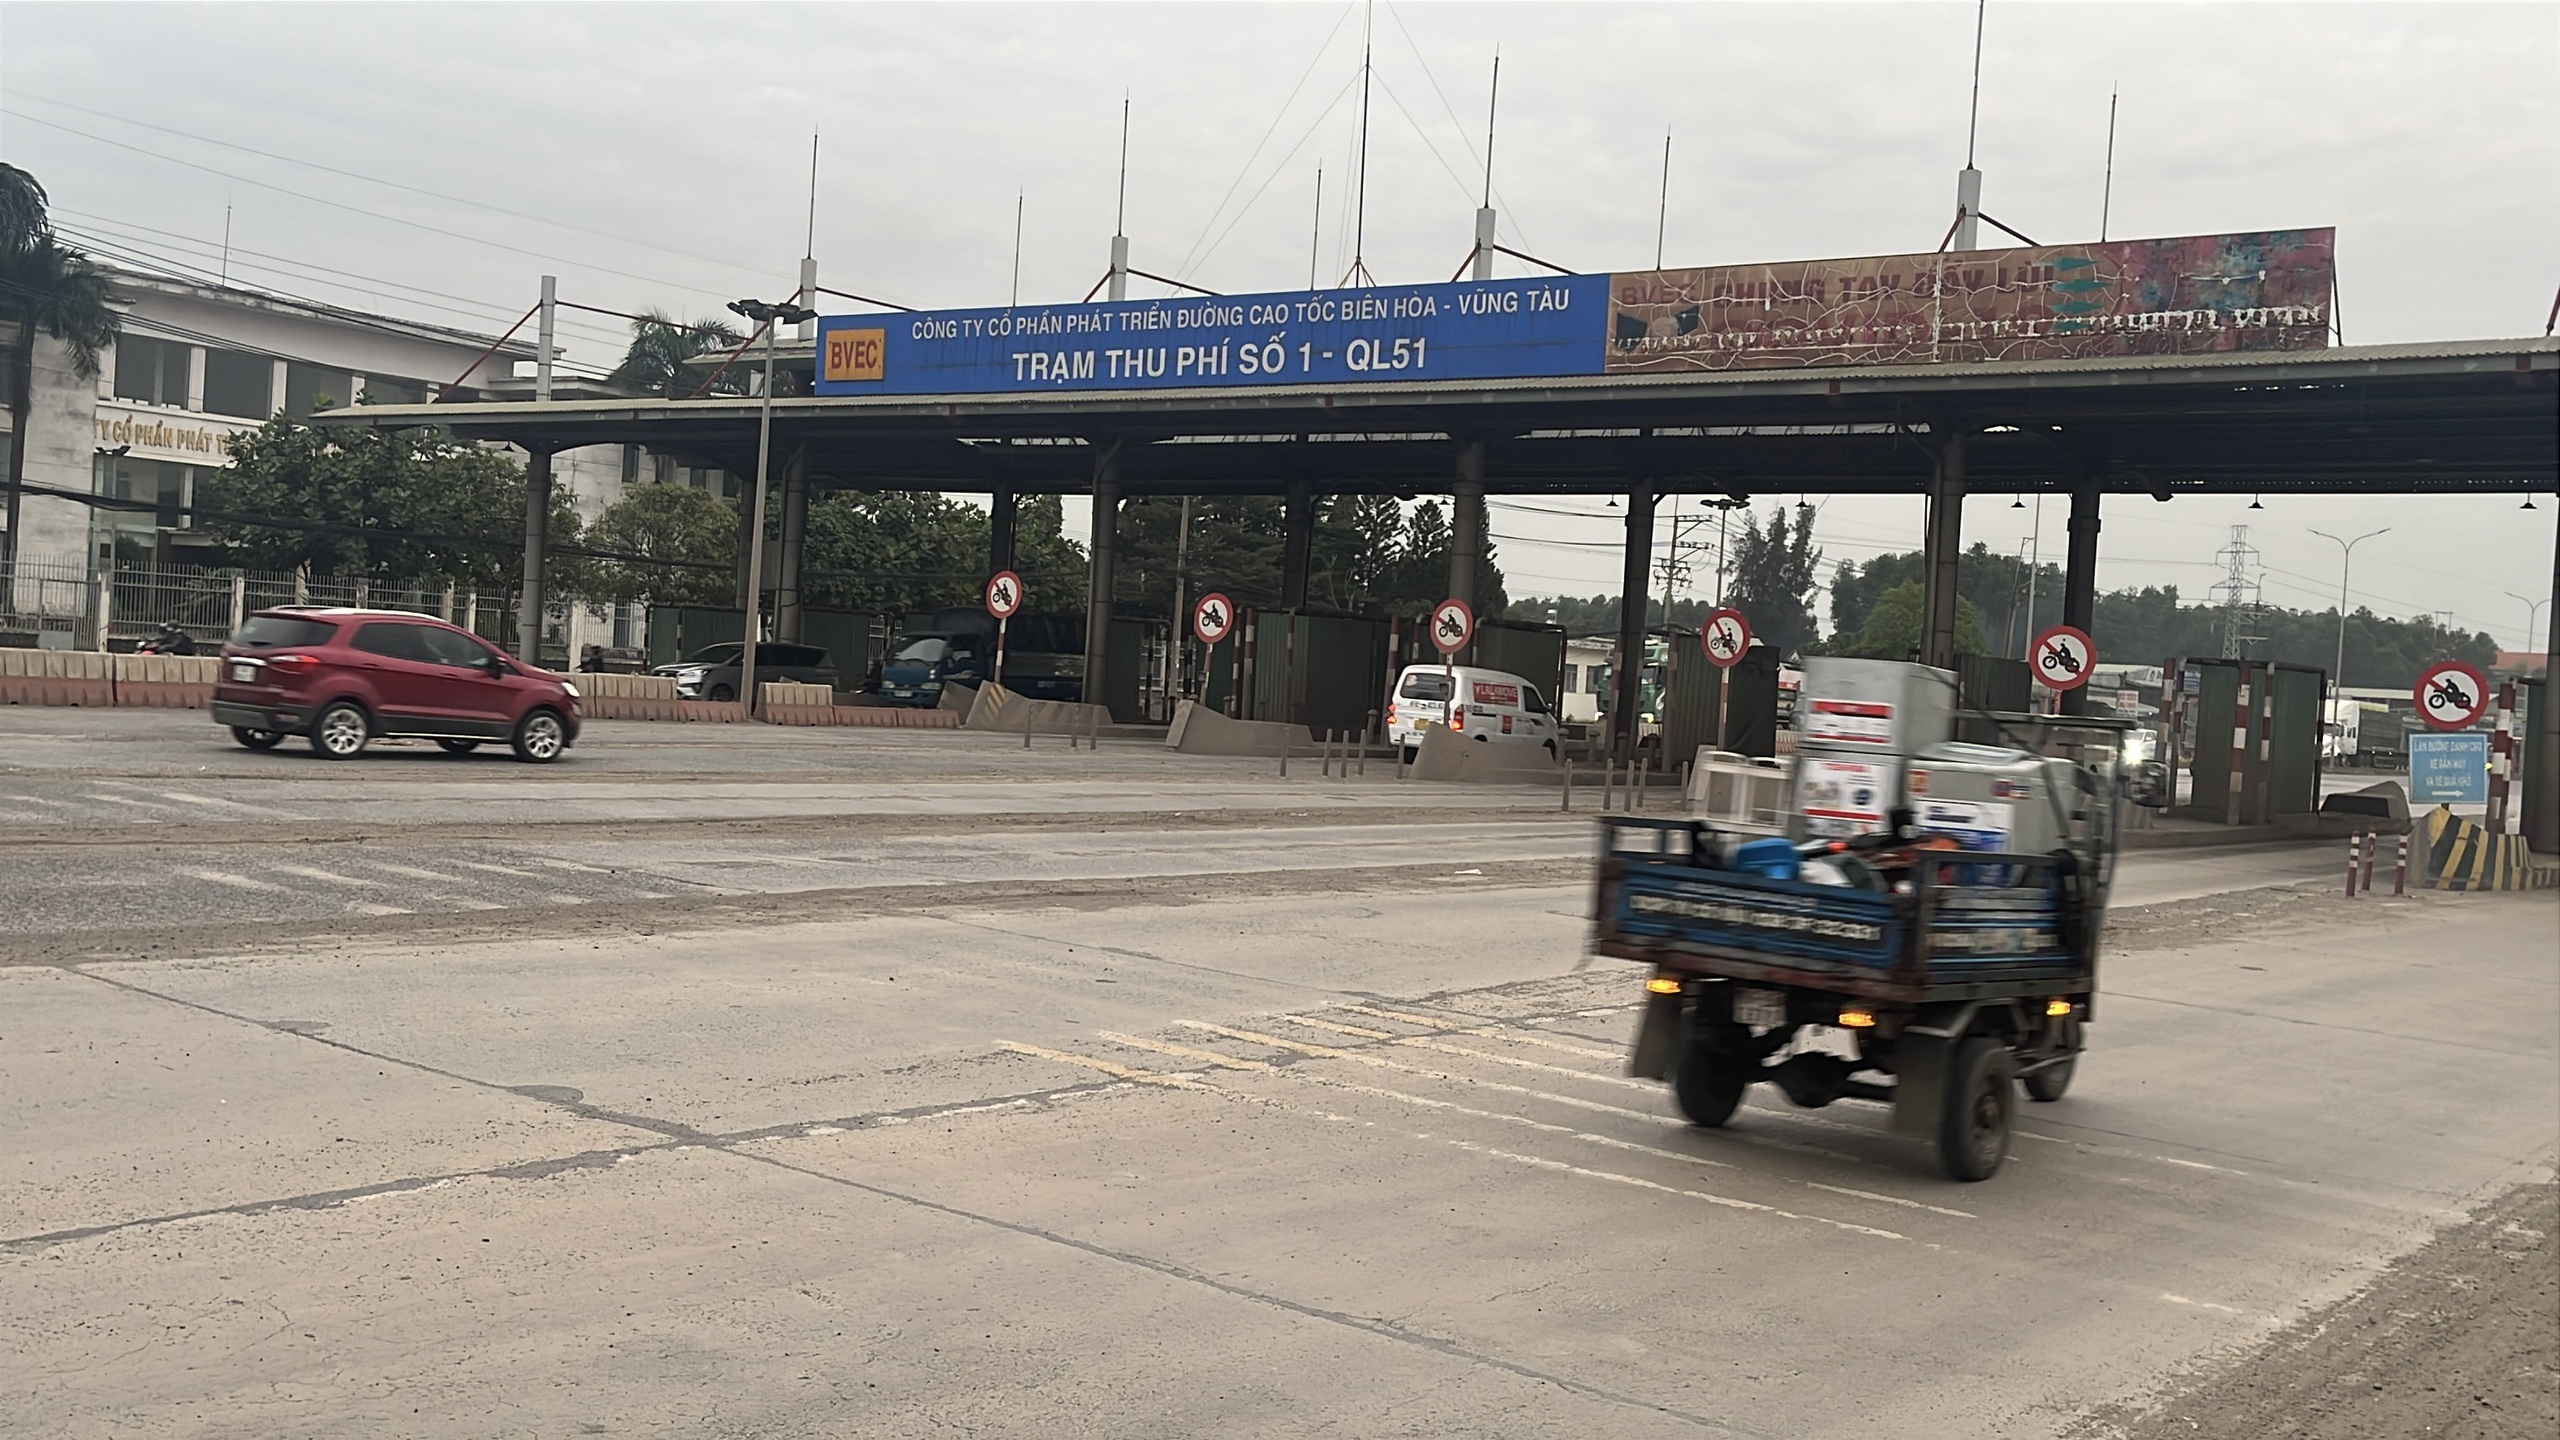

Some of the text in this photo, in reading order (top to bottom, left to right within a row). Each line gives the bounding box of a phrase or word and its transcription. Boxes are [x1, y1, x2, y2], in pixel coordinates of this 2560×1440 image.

[912, 316, 957, 340] CÔNG
[963, 319, 984, 338] TY
[988, 308, 1012, 337] CỔ
[1016, 309, 1063, 335] PHẦN
[1067, 308, 1114, 333] PHÁT
[1119, 301, 1171, 331] TRIỂN
[1177, 301, 1243, 329] ĐƯỜNG
[1249, 304, 1289, 326] CAO
[1295, 294, 1336, 323] TỐC
[1341, 293, 1388, 320] BIÊN
[1393, 290, 1437, 318] HÒA
[1458, 288, 1518, 315] VŨNG
[1527, 284, 1570, 312] TÀU
[831, 339, 879, 370] BVEC
[1012, 331, 1427, 384] TRẠM THU PHÍ SỐ 1 - QL51
[112, 413, 133, 443] CỔ
[135, 419, 173, 448] PHẦN
[177, 426, 213, 453] PHÁT
